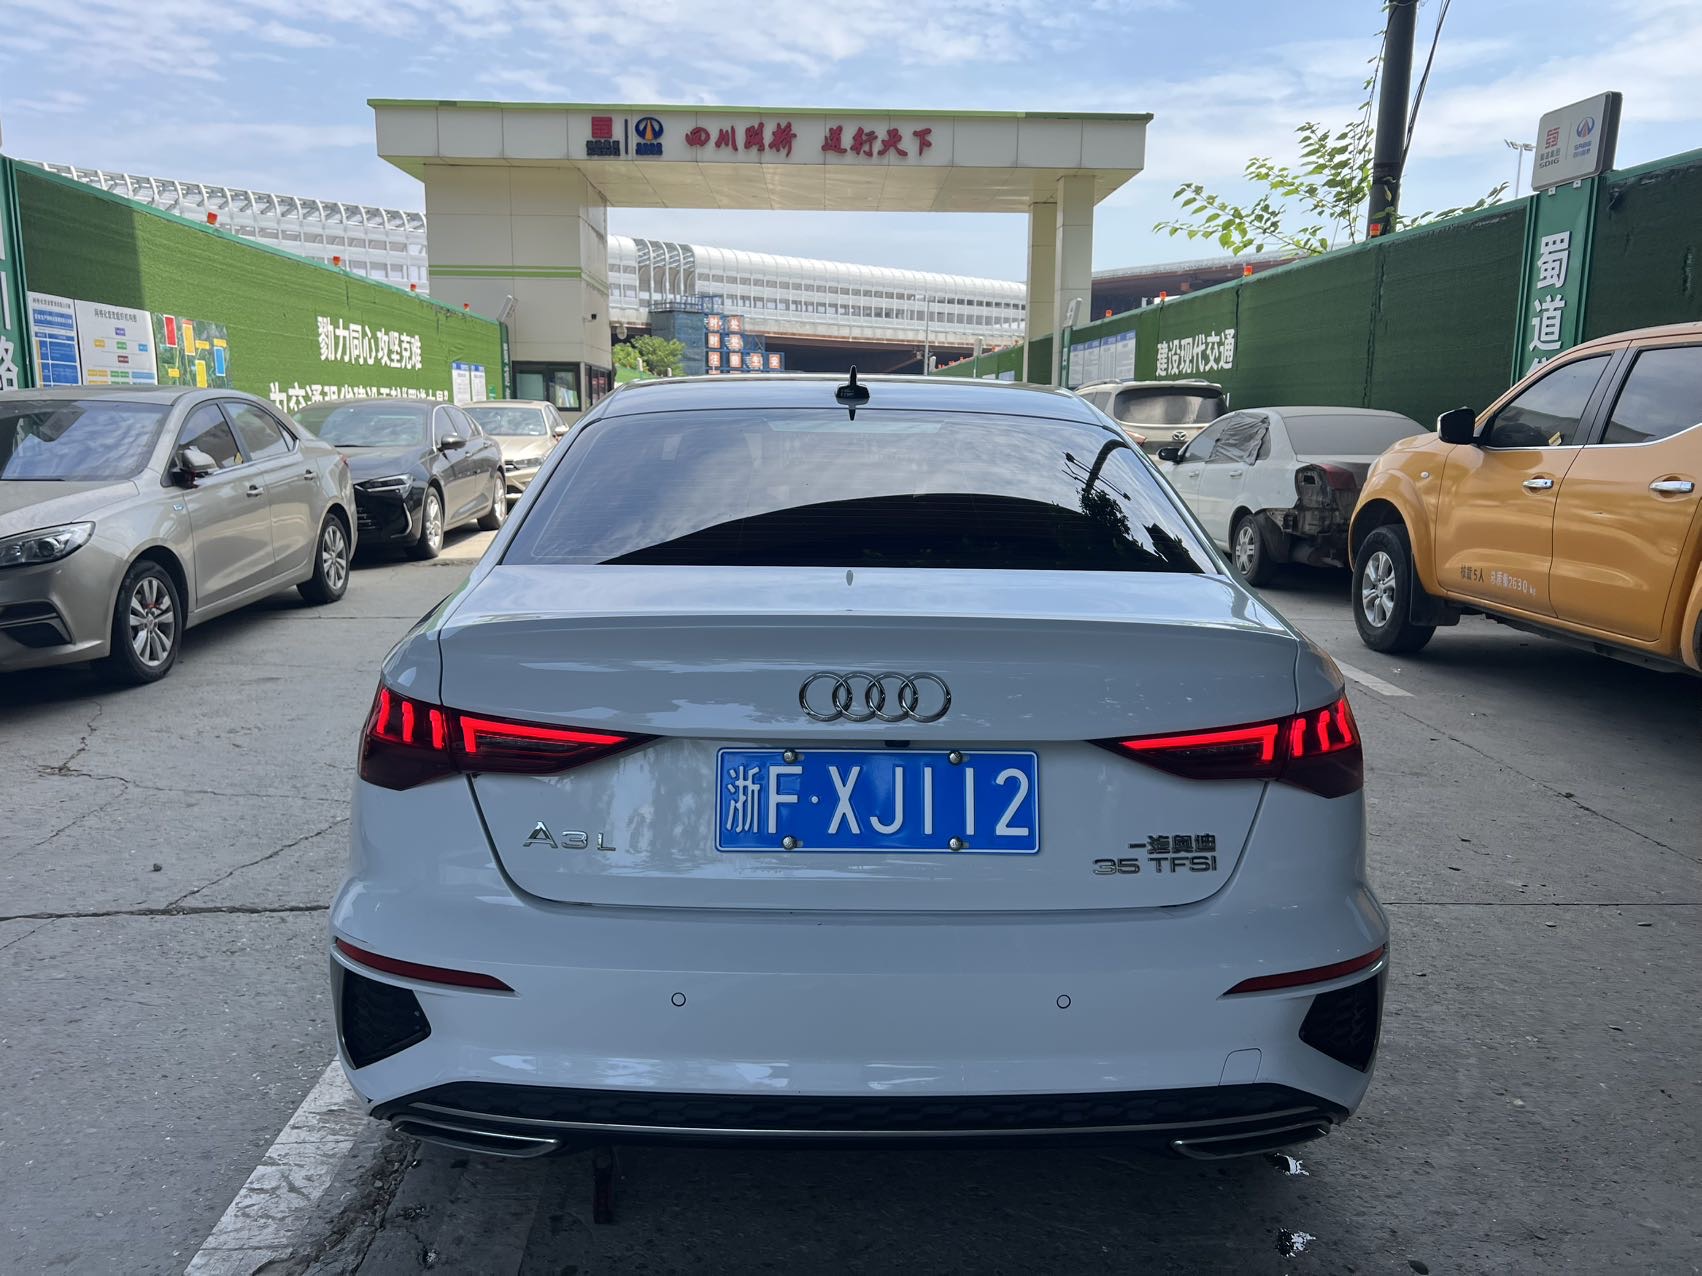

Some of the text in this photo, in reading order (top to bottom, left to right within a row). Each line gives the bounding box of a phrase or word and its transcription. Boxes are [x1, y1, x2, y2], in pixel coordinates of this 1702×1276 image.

[685, 121, 933, 157] 四川路桥 道行天下
[1538, 157, 1561, 169] SDIG
[317, 316, 422, 370] 勠力同心 攻坚克难
[1156, 328, 1235, 376] 建设现代交通
[726, 764, 1030, 837] 浙F·XJ112
[1093, 855, 1217, 875] 35 TFSI
